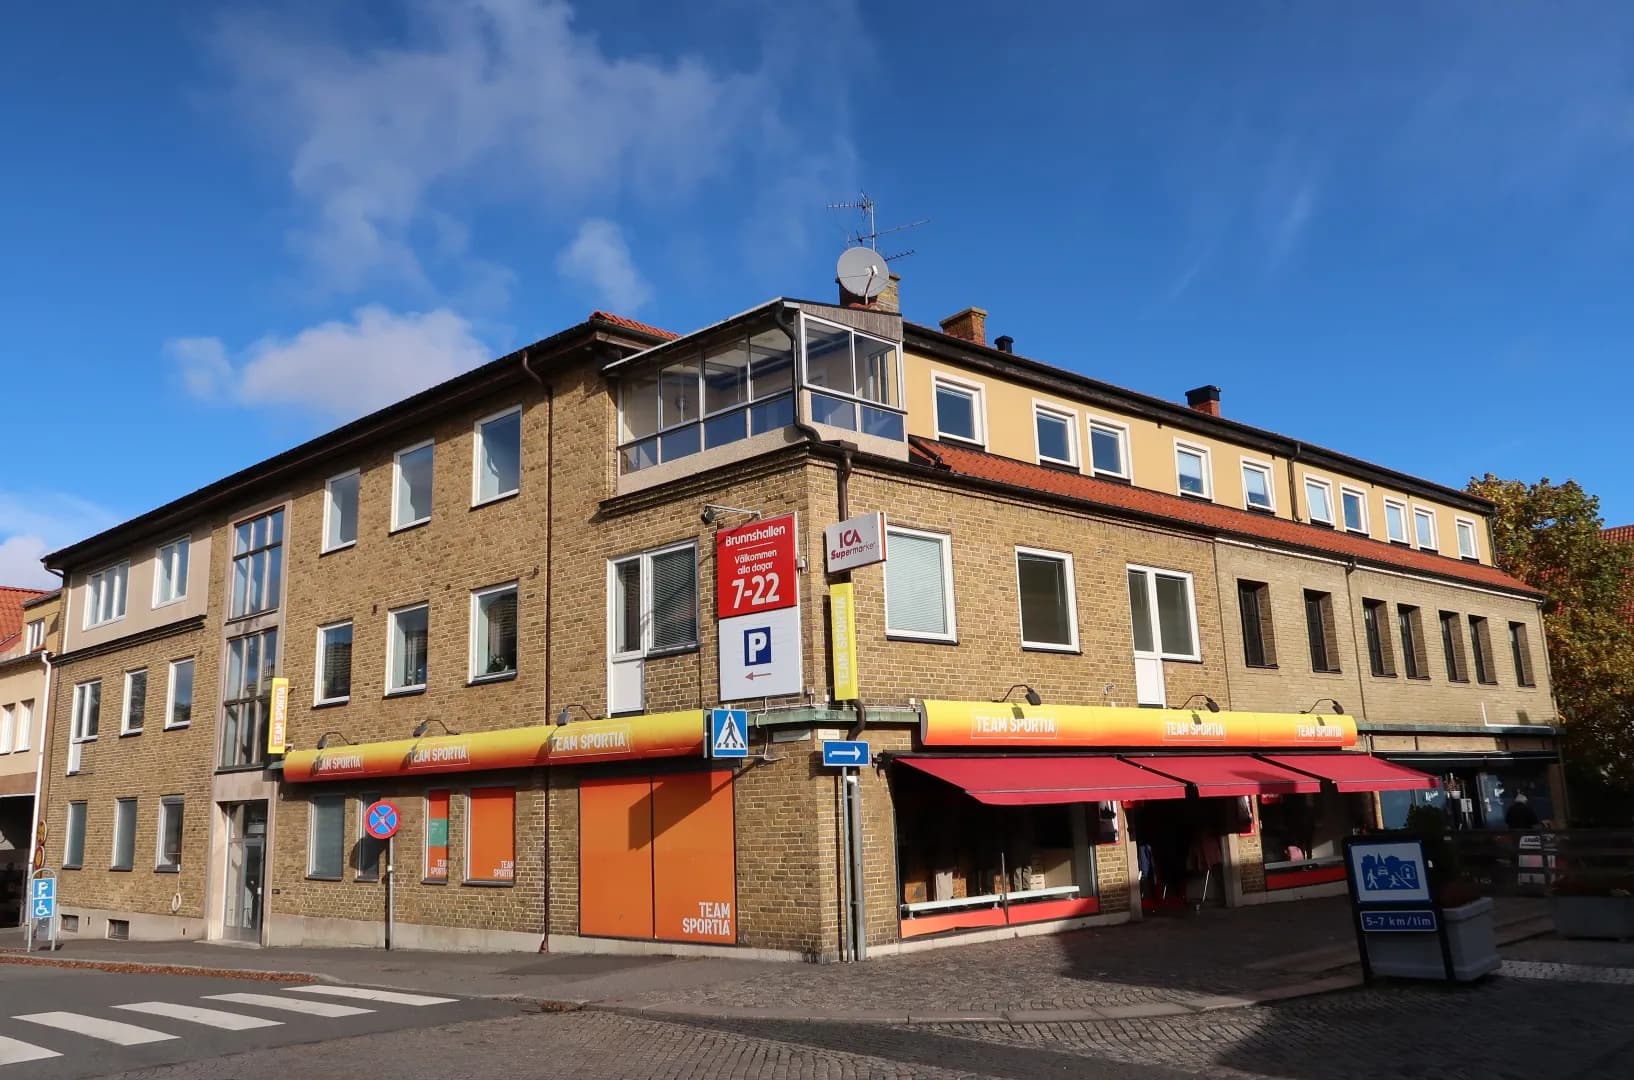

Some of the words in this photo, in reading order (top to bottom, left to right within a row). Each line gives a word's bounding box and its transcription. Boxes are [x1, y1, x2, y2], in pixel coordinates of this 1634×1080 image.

[725, 525, 786, 547] Brunnshallen
[839, 529, 862, 549] ICA
[735, 549, 777, 564] Välkommen
[737, 565, 751, 575] alla
[752, 561, 773, 573] dagar
[731, 572, 780, 609] 7-22
[834, 597, 848, 649] SPORTIA
[748, 631, 767, 663] P
[837, 653, 849, 687] TEAM
[275, 687, 286, 721] SPORTIA
[273, 722, 284, 745] TEAM
[976, 716, 1008, 732] TEAM
[1010, 717, 1055, 733] SPORTIA
[1166, 722, 1189, 736] TEAM
[1190, 722, 1224, 737] SPORTIA
[1297, 725, 1316, 737] TEAM
[1317, 725, 1344, 738] SPORTIA
[550, 735, 578, 753] TEAM
[580, 731, 626, 750] SPORTIA
[332, 755, 361, 769] SPORTIA
[409, 749, 431, 764] TEAM
[432, 745, 467, 762] SPORTIA
[430, 866, 448, 876] SPORTI
[437, 858, 448, 868] TEA
[38, 881, 49, 896] P
[699, 901, 731, 919] TEAM
[682, 917, 731, 936] SPORTIA
[1366, 916, 1384, 926] 5-7
[1389, 915, 1431, 927] km/tim
